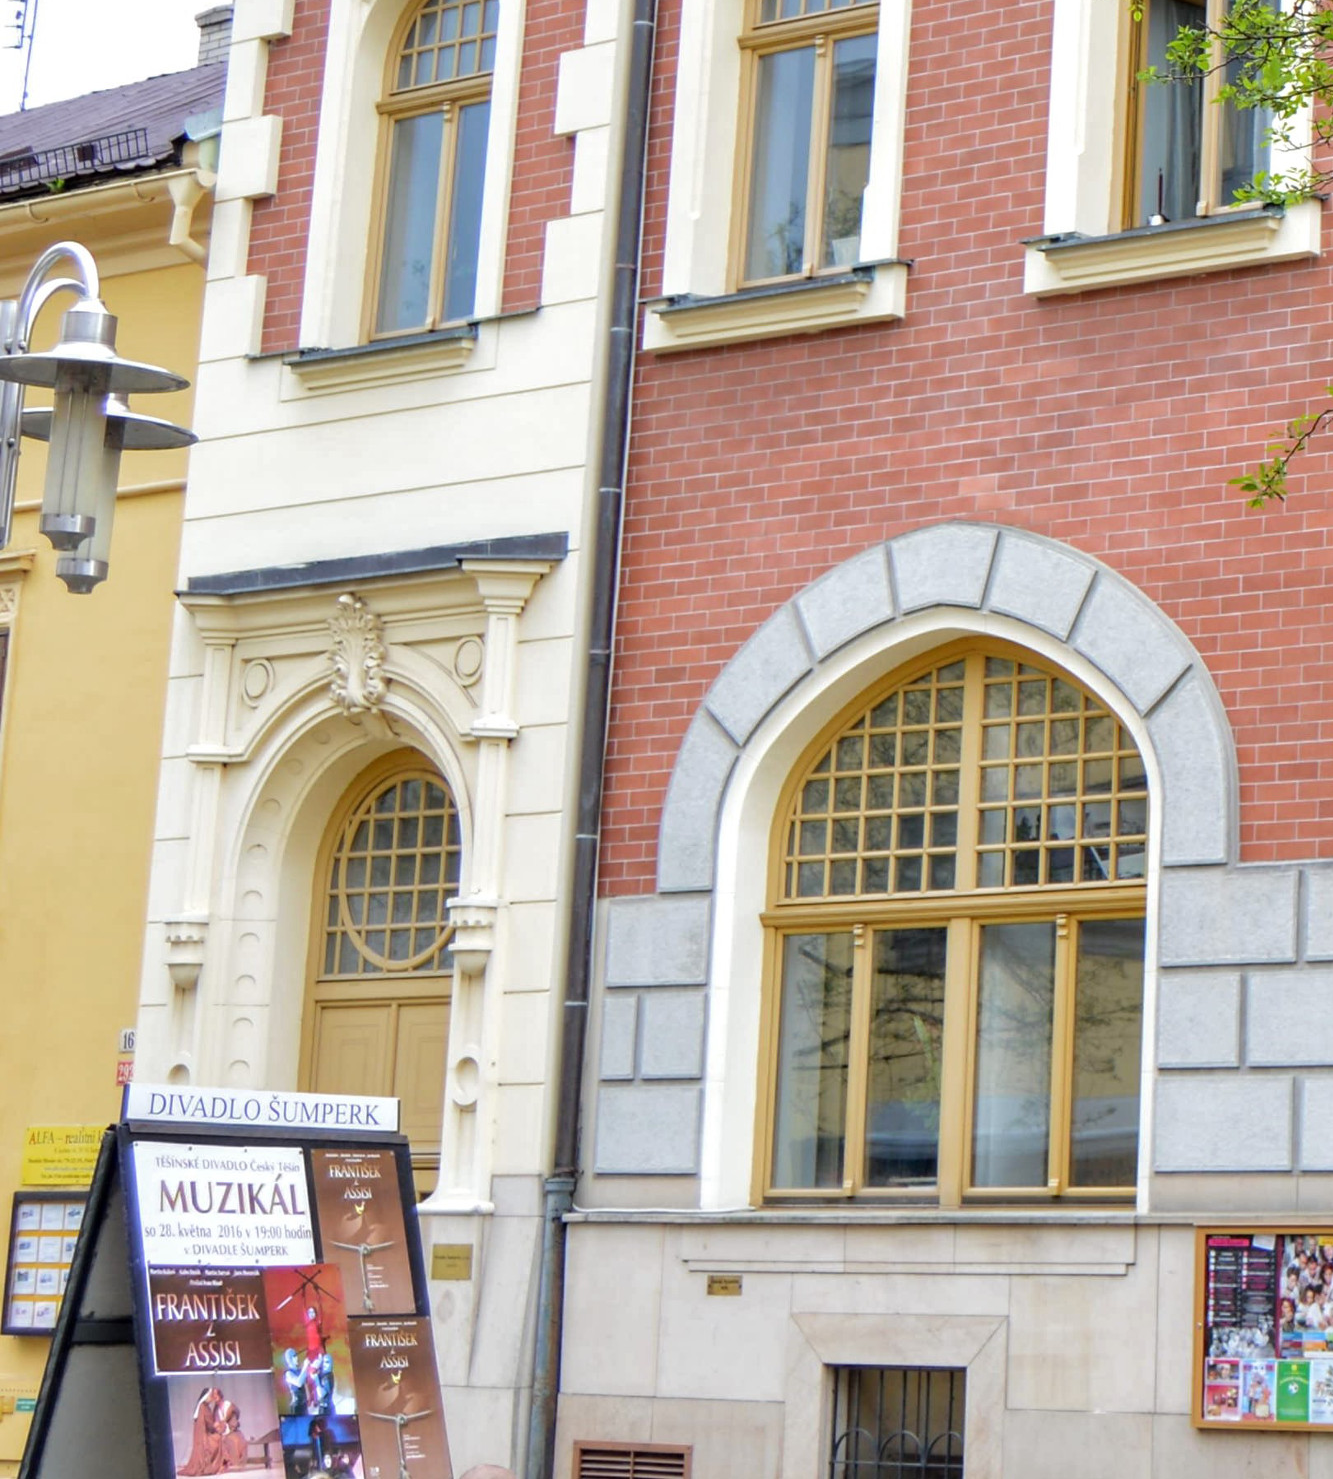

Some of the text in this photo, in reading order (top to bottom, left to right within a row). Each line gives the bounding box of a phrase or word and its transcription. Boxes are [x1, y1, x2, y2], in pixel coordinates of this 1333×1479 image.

[123, 1031, 135, 1050] 16
[149, 1093, 380, 1125] DIVADLO ŠUMPERK
[29, 1130, 55, 1145] ALFA
[155, 1156, 200, 1170] TĚŠÍNSKÉ
[202, 1159, 248, 1171] DIVADLO
[329, 1163, 381, 1178] FRANTIŠEK
[159, 1174, 306, 1216] MUZIKÁL
[144, 1227, 156, 1238] so
[159, 1223, 176, 1238] 28.
[178, 1222, 212, 1238] května
[218, 1225, 243, 1239] 2016
[255, 1225, 282, 1239] 19:00
[284, 1224, 312, 1240] hodin
[192, 1243, 238, 1256] DIVADLE
[241, 1242, 289, 1256] ŠUMPERK
[156, 1287, 260, 1320] FRANTIŠEK
[365, 1332, 419, 1347] FRANTIŠEK
[185, 1341, 242, 1367] ASSISI
